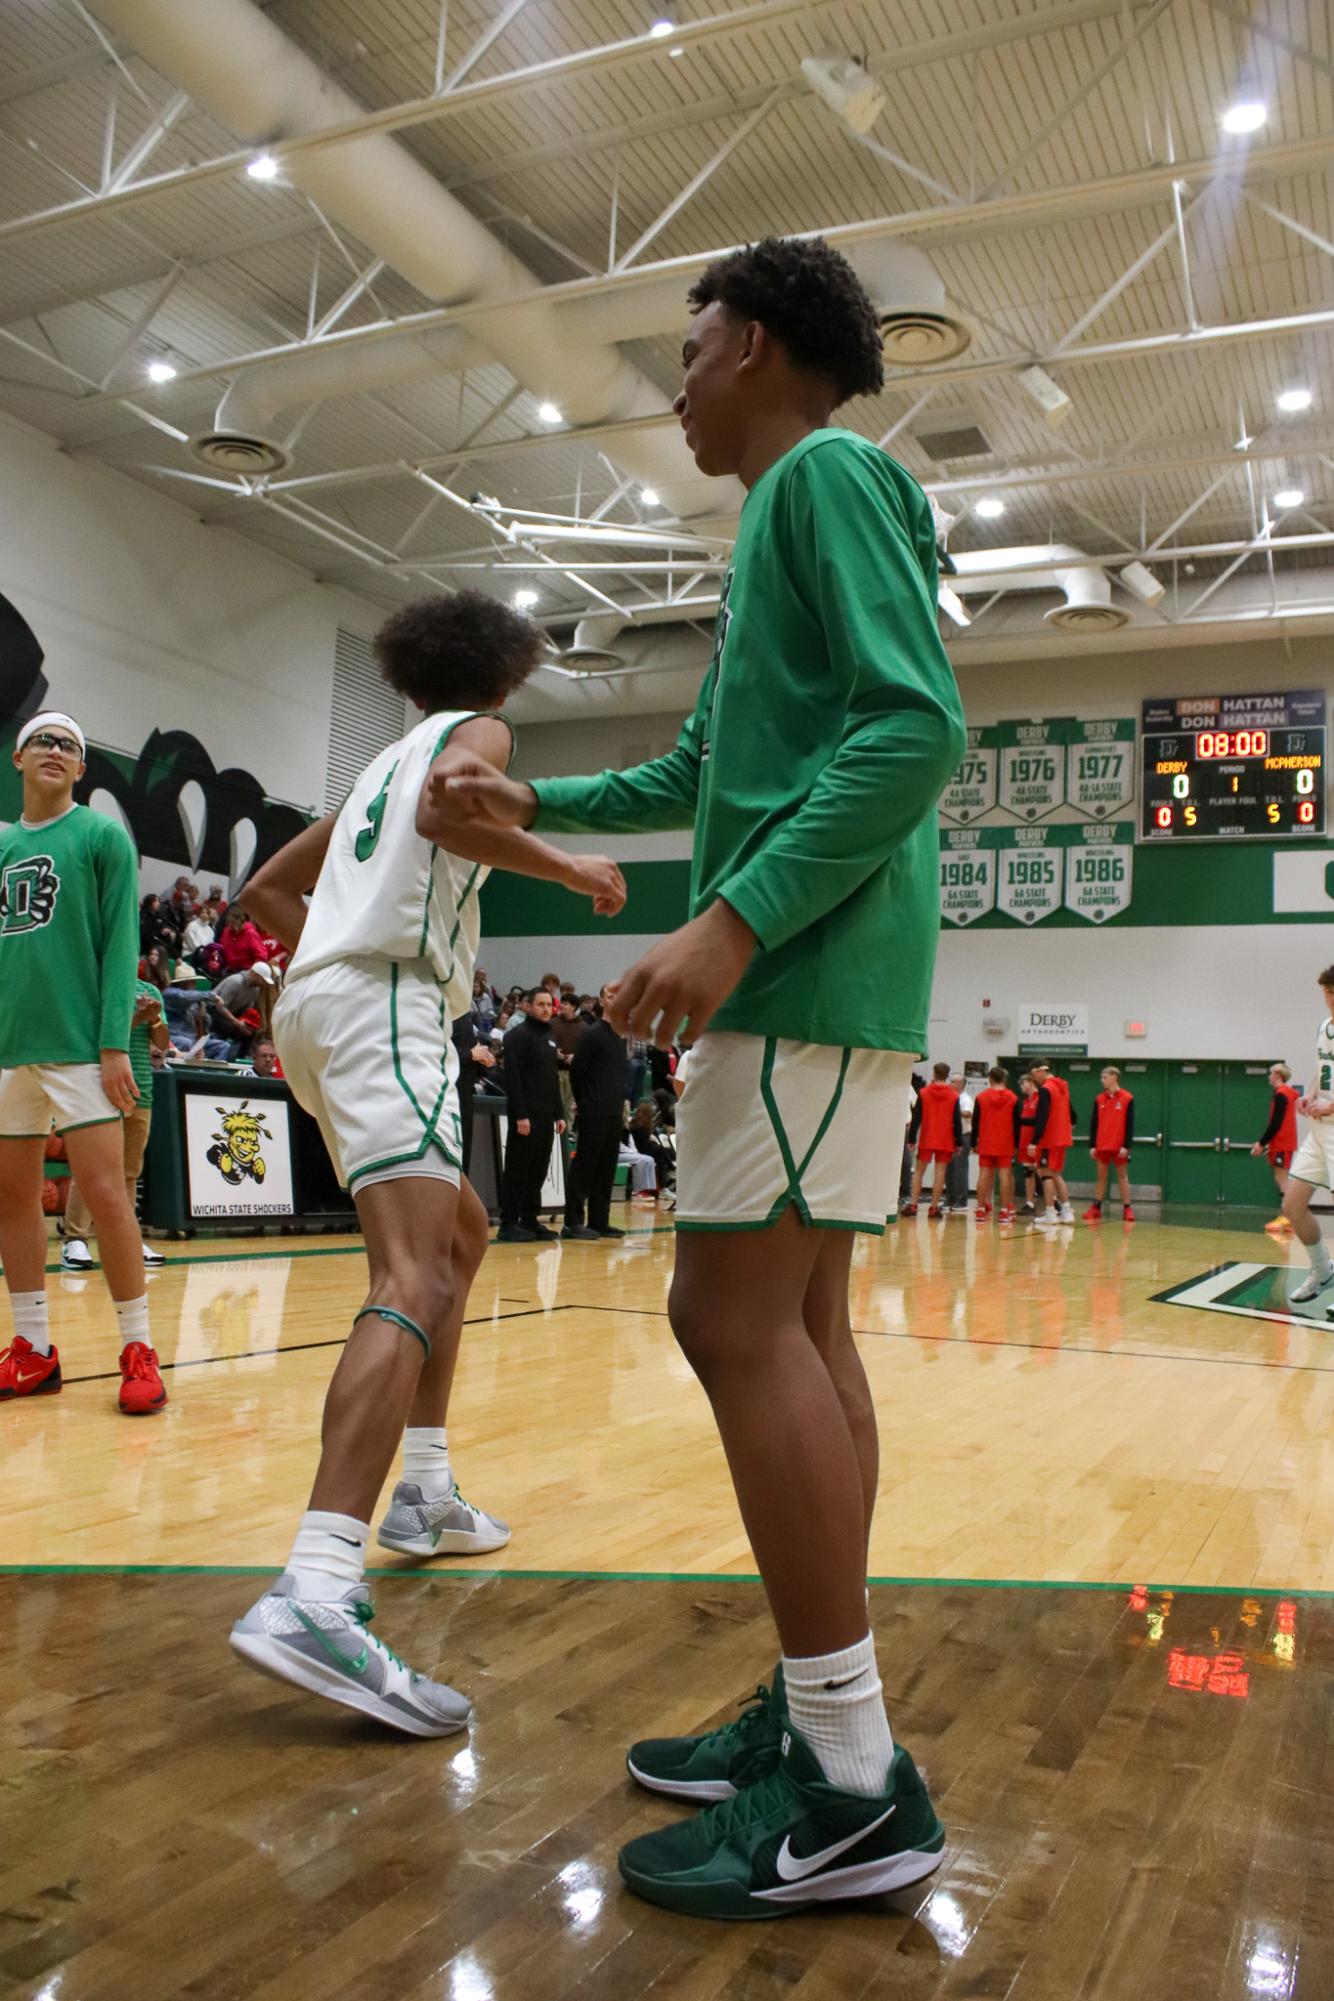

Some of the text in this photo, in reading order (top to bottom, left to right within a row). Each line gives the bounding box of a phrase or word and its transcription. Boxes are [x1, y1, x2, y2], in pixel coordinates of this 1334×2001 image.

[1181, 700, 1216, 713] DON
[1223, 697, 1286, 711] HATTAN
[1181, 716, 1216, 729] DON
[1223, 711, 1286, 726] HATTAN
[1016, 726, 1050, 739] DERBY
[1083, 722, 1118, 737] DERBY
[1198, 731, 1267, 757] 08:00
[1078, 755, 1124, 780] 1977
[1156, 761, 1188, 774] DERBY
[1264, 755, 1322, 769] MCPHERSON
[952, 762, 987, 785] 975
[1010, 758, 1055, 783] 1976
[1173, 774, 1190, 799] 0
[1231, 776, 1239, 793] 1
[1296, 769, 1314, 794] 0
[1158, 807, 1172, 827] 0
[1300, 802, 1314, 822] 0
[949, 831, 981, 843] DERBY
[1015, 828, 1048, 841] DERBY
[1083, 826, 1117, 839] DERBY
[940, 863, 987, 887] 1984
[1008, 861, 1054, 885] 1985
[1075, 858, 1124, 883] 1986
[959, 890, 978, 899] STATE
[1026, 888, 1045, 897] STATE
[1095, 886, 1115, 895] STATE
[943, 900, 984, 909] CHAMPIONS
[1009, 898, 1051, 907] CHAMPIONS
[1078, 896, 1121, 906] CHAMPIONS
[1320, 1065, 1331, 1090] 2
[193, 1203, 292, 1215] WICHITA STATE SHOCKERS
